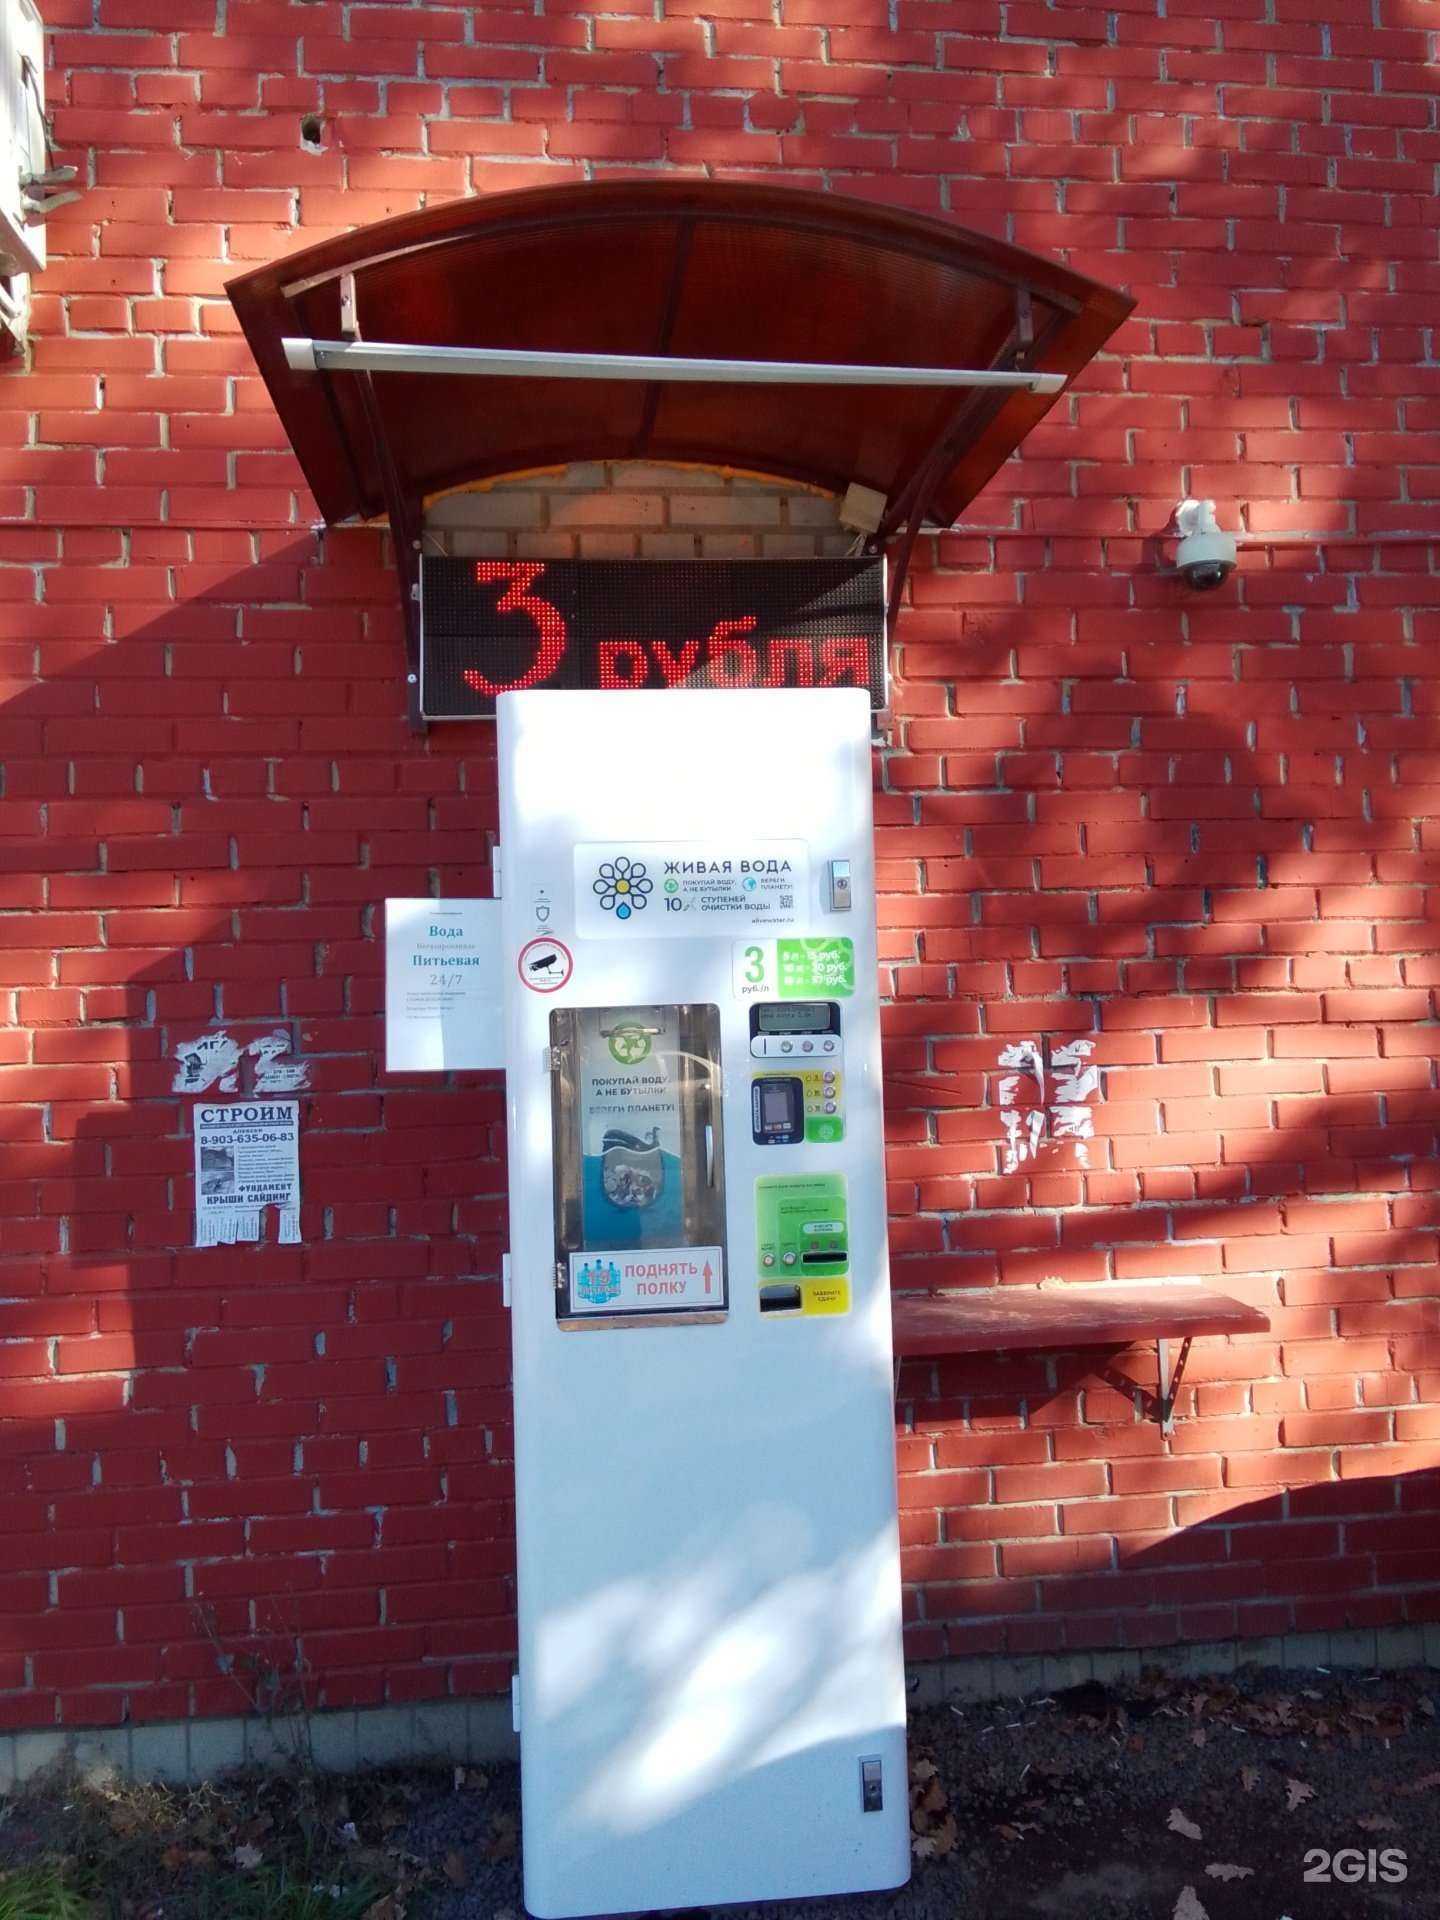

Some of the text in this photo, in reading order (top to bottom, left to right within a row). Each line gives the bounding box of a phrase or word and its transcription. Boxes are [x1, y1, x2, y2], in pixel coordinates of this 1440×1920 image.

[464, 561, 567, 696] 3
[664, 860, 792, 875] ЖИВАЯ ВОДА
[682, 878, 716, 887] ПОКУПАЙ
[664, 897, 682, 912] 10
[701, 894, 747, 904] СТУПЕНЕЙ
[701, 902, 771, 912] ОЧИСТКИ ВОДЫ
[428, 925, 464, 939] Вода
[413, 954, 481, 967] Питьевая
[744, 945, 765, 983] 3
[430, 973, 463, 988] 24/7
[591, 1075, 640, 1087] ПОКУПАЙ
[595, 1089, 602, 1097] А
[605, 1088, 618, 1097] НЕ
[200, 1106, 293, 1123] СТРОИМ
[627, 1103, 675, 1114] ПЛАНЕТУ!
[200, 1132, 295, 1145] 8-903-635-06-83
[239, 1183, 292, 1193] ФУНДАМЕНТ
[206, 1192, 292, 1205] КРЫШИ САЙДИНГ
[624, 1261, 699, 1279] ПОДНЯТЬ
[636, 1280, 687, 1296] ПОЛКУ
